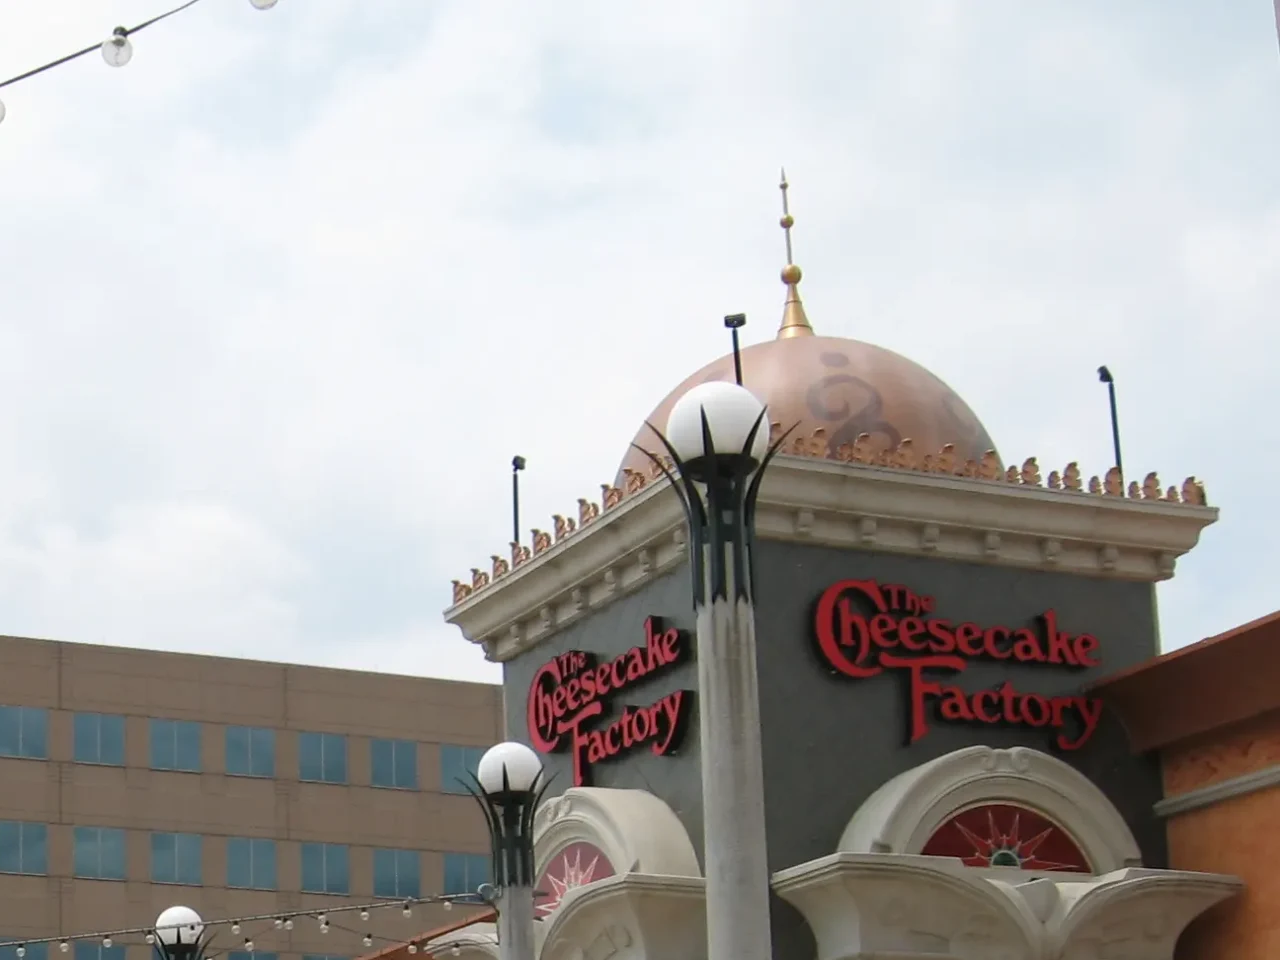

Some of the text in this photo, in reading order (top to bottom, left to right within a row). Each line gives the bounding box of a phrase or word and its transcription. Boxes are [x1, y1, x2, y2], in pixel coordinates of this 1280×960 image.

[816, 579, 1101, 677] Cheesecake
[883, 584, 936, 616] The
[527, 616, 680, 754] Cheesecake
[560, 652, 587, 678] The
[879, 652, 1103, 750] Factory
[557, 690, 683, 788] Factory
